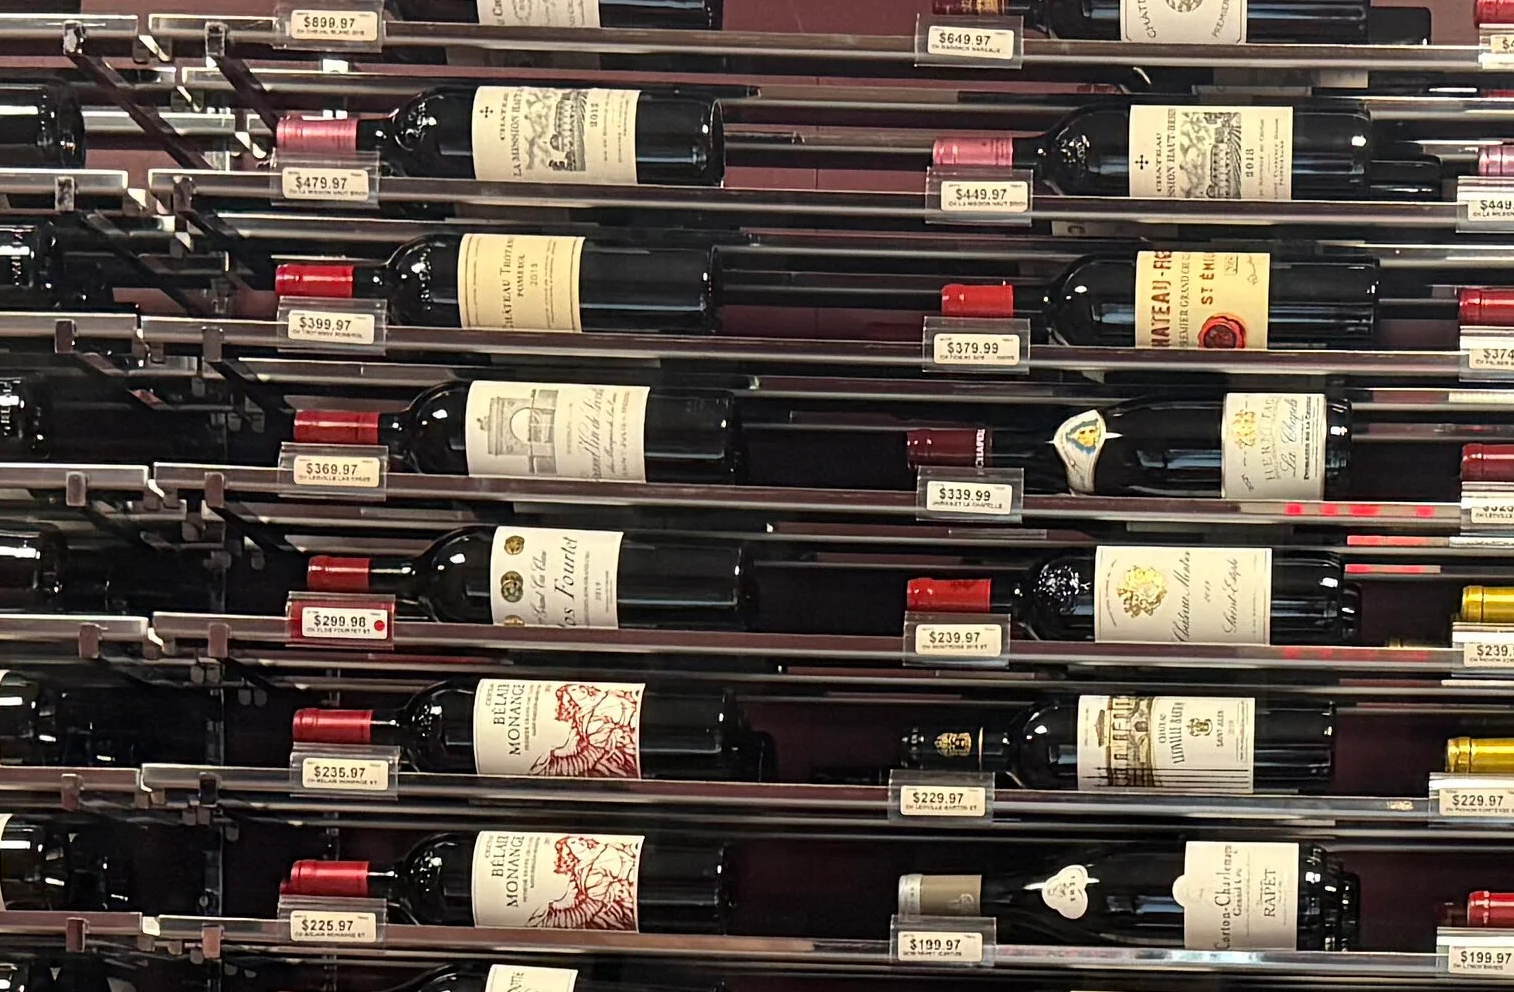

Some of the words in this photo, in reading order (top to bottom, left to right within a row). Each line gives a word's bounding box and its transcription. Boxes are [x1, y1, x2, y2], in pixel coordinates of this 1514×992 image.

[303, 15, 355, 29] $899.97
[938, 32, 991, 46] $649.97
[295, 175, 347, 190] $479.97
[955, 188, 1007, 201] $449.97
[299, 316, 352, 331] $399.97
[947, 341, 999, 354] $379.99
[306, 462, 358, 476] $369.97
[939, 487, 991, 502] $339.99
[313, 614, 366, 628] $299.98
[929, 630, 980, 644] $239.97
[506, 683, 524, 756] MONANGE
[912, 791, 964, 804] $229.97
[1452, 794, 1504, 806] $229.97
[1263, 868, 1276, 917] RAPET
[909, 938, 961, 951] $199.97
[1460, 950, 1512, 964] $199.97
